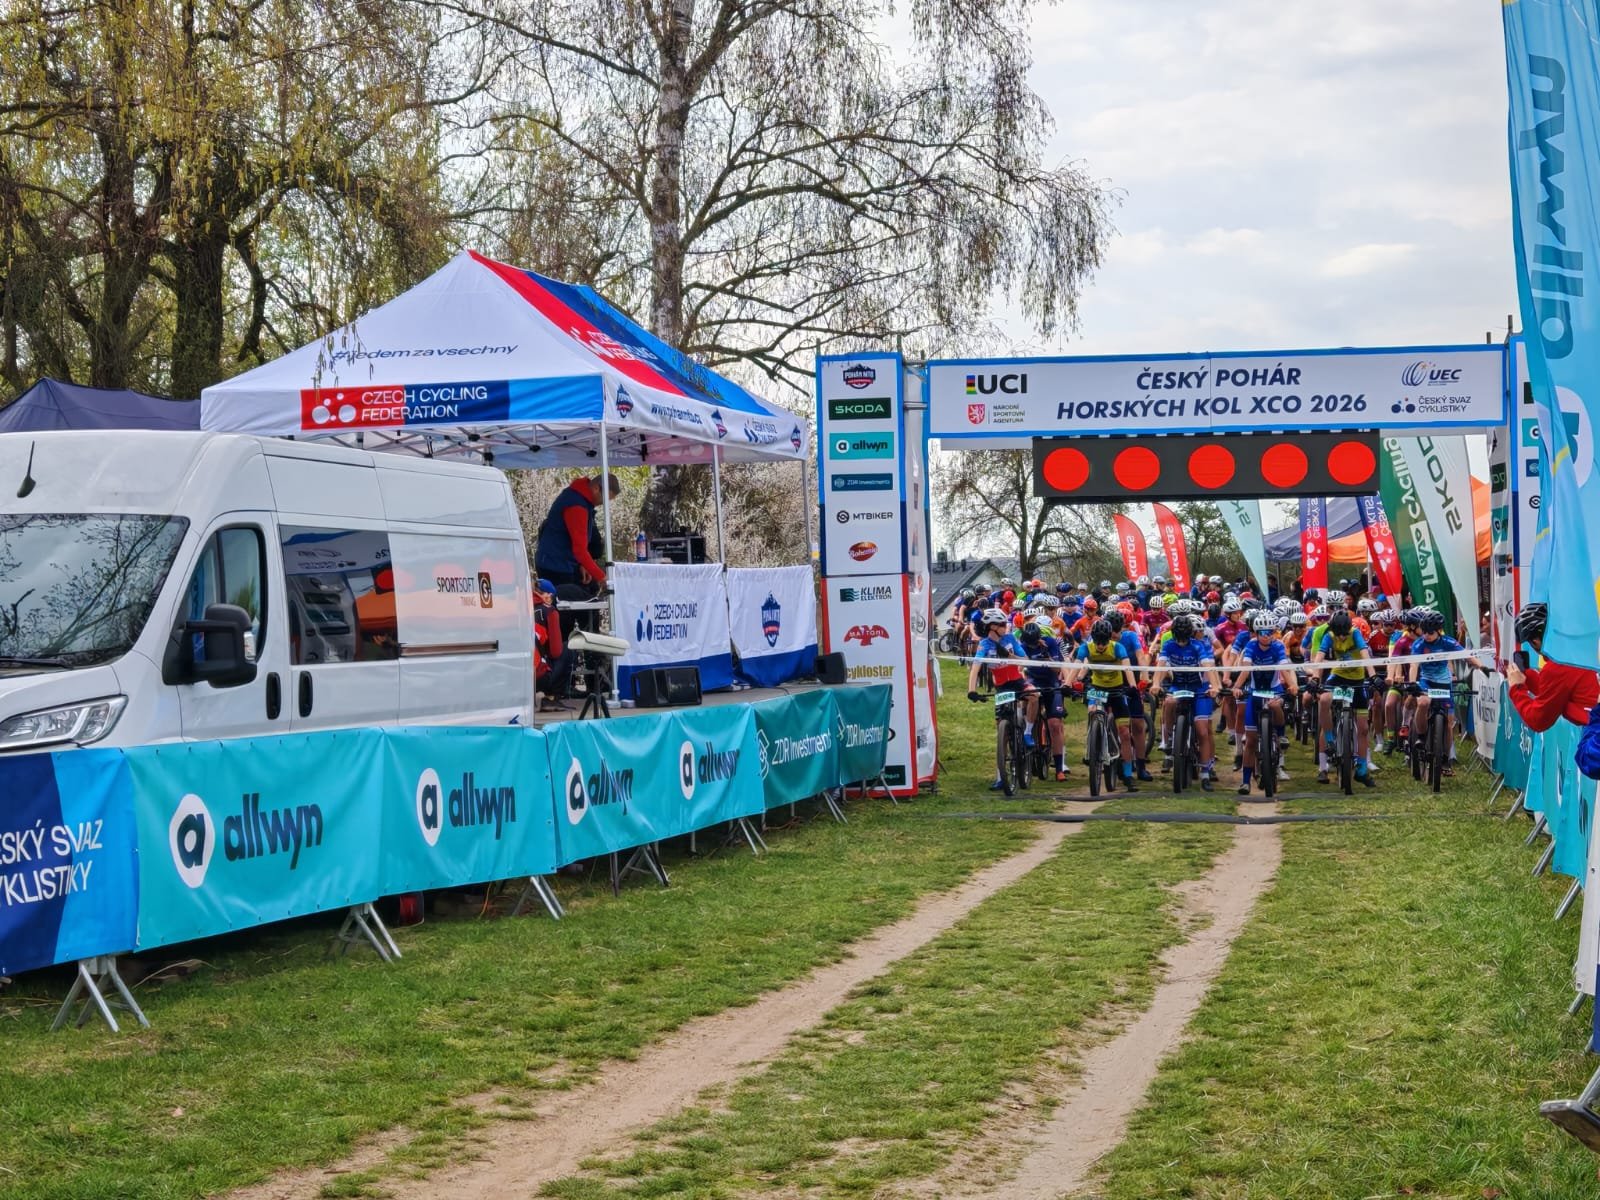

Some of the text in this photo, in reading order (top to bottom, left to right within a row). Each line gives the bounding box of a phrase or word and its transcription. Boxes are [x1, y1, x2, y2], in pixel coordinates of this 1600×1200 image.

[978, 374, 1027, 394] UCI
[1137, 362, 1302, 390] ČESKÝ POHÁR
[1430, 368, 1462, 381] UEC
[361, 386, 488, 405] CZECH CYCLING
[1418, 395, 1471, 405] ČESKÝ SVAZ
[361, 404, 458, 421] FEDERATION
[1057, 394, 1367, 420] HORSKÝCH KOL XCO 2026
[1418, 405, 1467, 413] CYKLISTIKY
[852, 440, 888, 452] allwyn
[853, 512, 893, 520] MTBIKER
[861, 586, 892, 596] KLIMA
[772, 737, 789, 765] ZDR
[448, 772, 516, 840] allwyn
[224, 793, 324, 870] allwyn
[0, 819, 103, 864] SKÝ SVAZ
[0, 860, 92, 906] KLISTIKY
